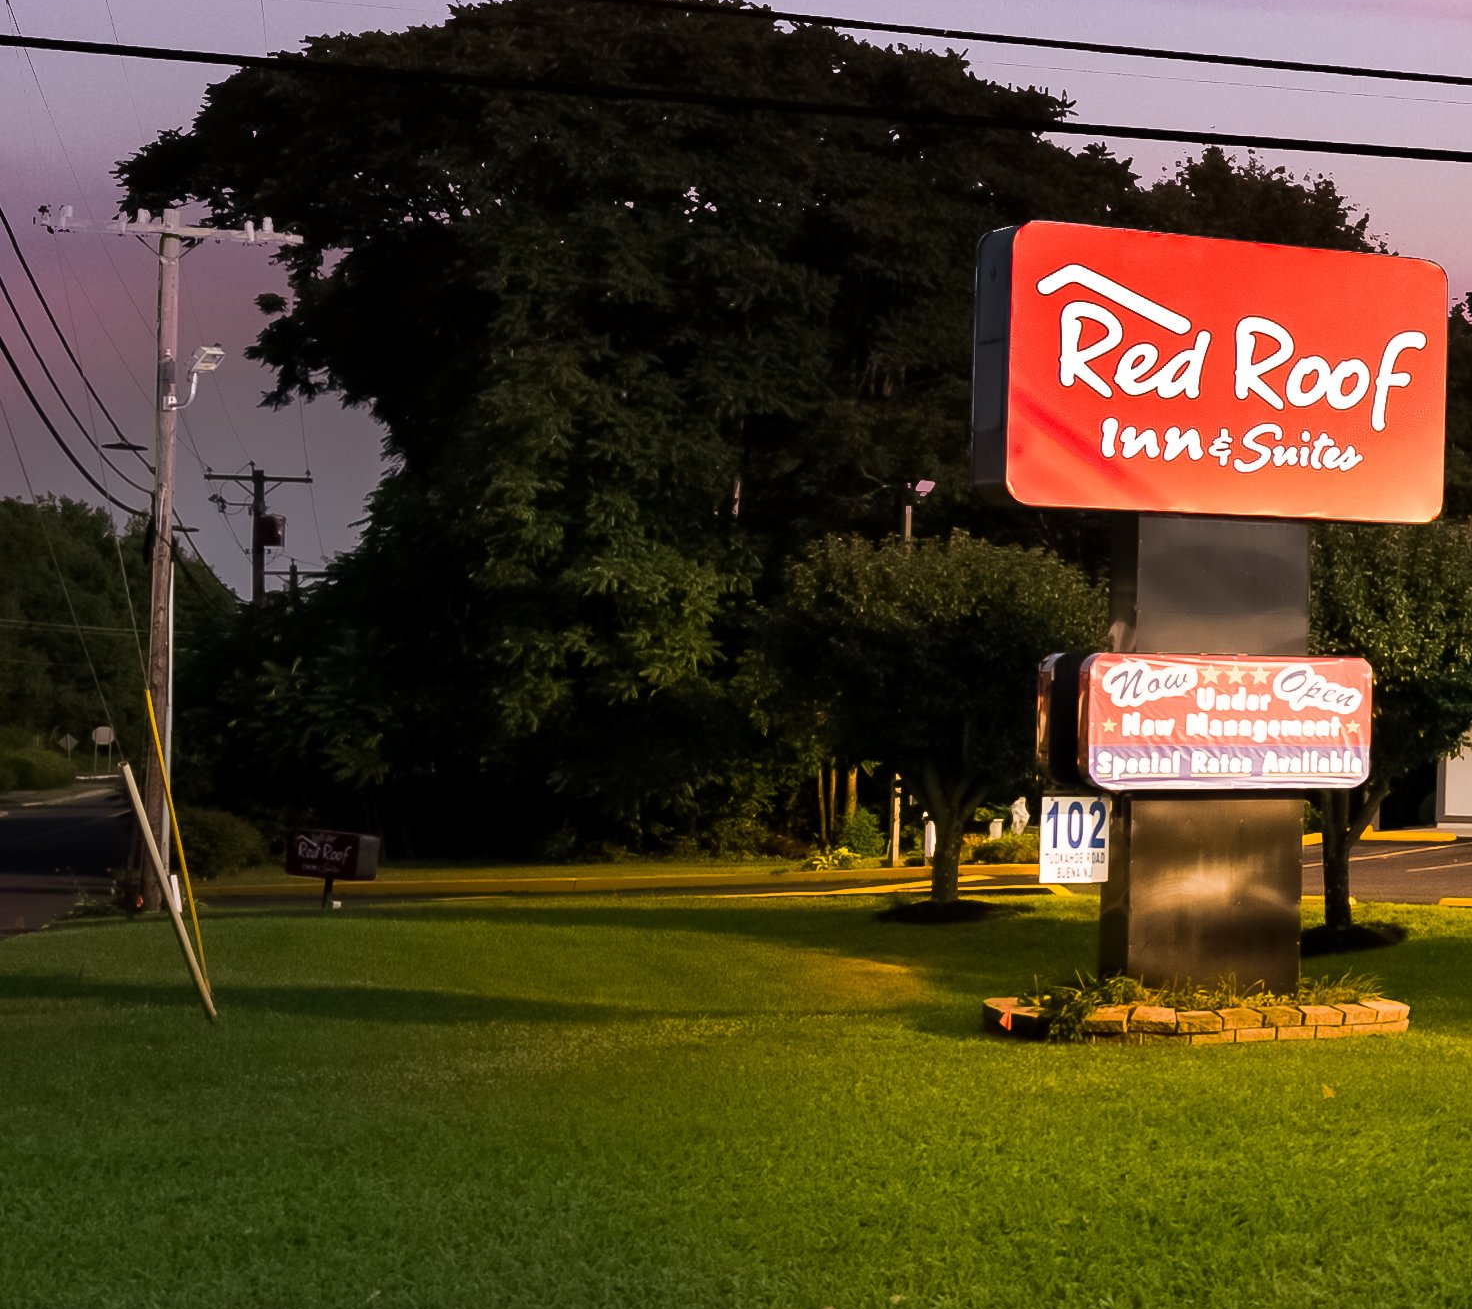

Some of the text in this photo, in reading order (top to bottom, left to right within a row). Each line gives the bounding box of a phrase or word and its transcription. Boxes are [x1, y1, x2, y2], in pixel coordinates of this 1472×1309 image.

[1059, 301, 1428, 432] Red Roof
[1100, 418, 1364, 474] Inn & Suites
[1111, 669, 1355, 707] Now Open
[1196, 687, 1272, 711] Under
[1122, 712, 1341, 743] New Management
[1096, 751, 1363, 780] Special Rates Available
[1045, 801, 1107, 849] 102
[298, 841, 353, 865] Red Roof
[1086, 852, 1106, 864] ROAD
